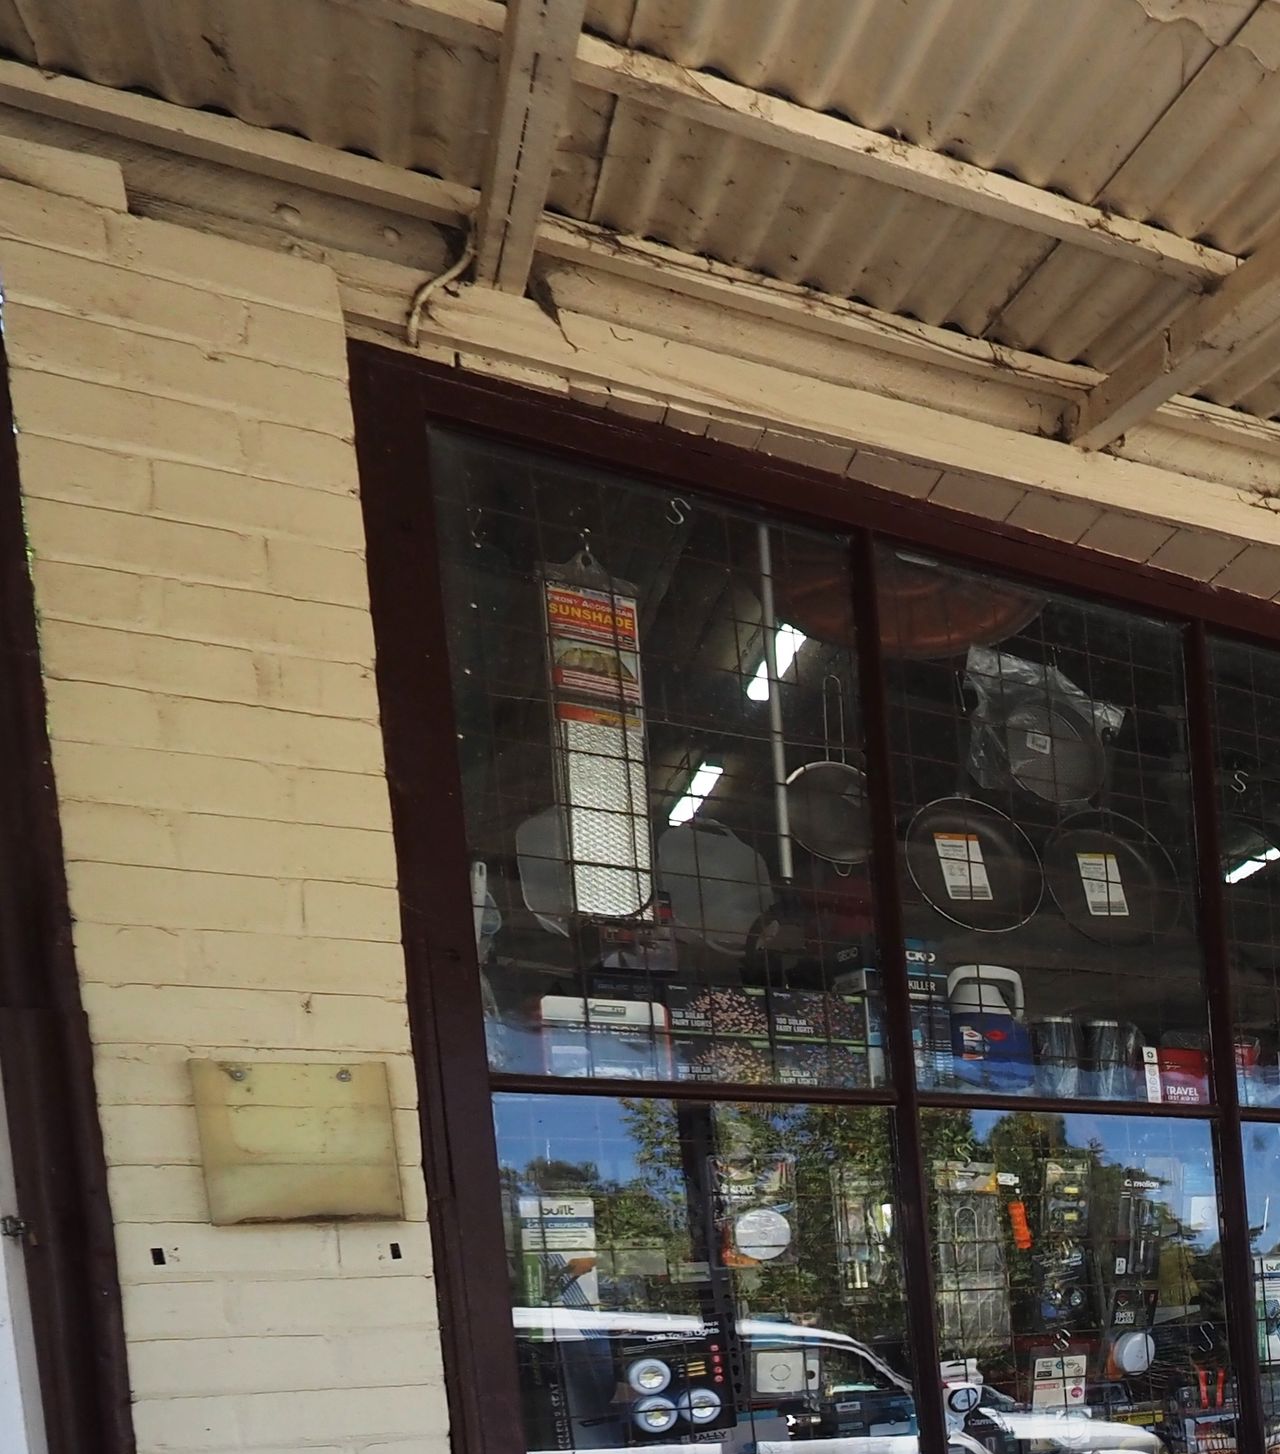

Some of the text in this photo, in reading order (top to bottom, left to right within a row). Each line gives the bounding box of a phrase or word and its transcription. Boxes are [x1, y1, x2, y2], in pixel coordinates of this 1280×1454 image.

[548, 602, 634, 630] SUNSHADE
[905, 950, 937, 963] CKO
[908, 979, 937, 992] KILLER
[1167, 1085, 1200, 1097] TRAVEL
